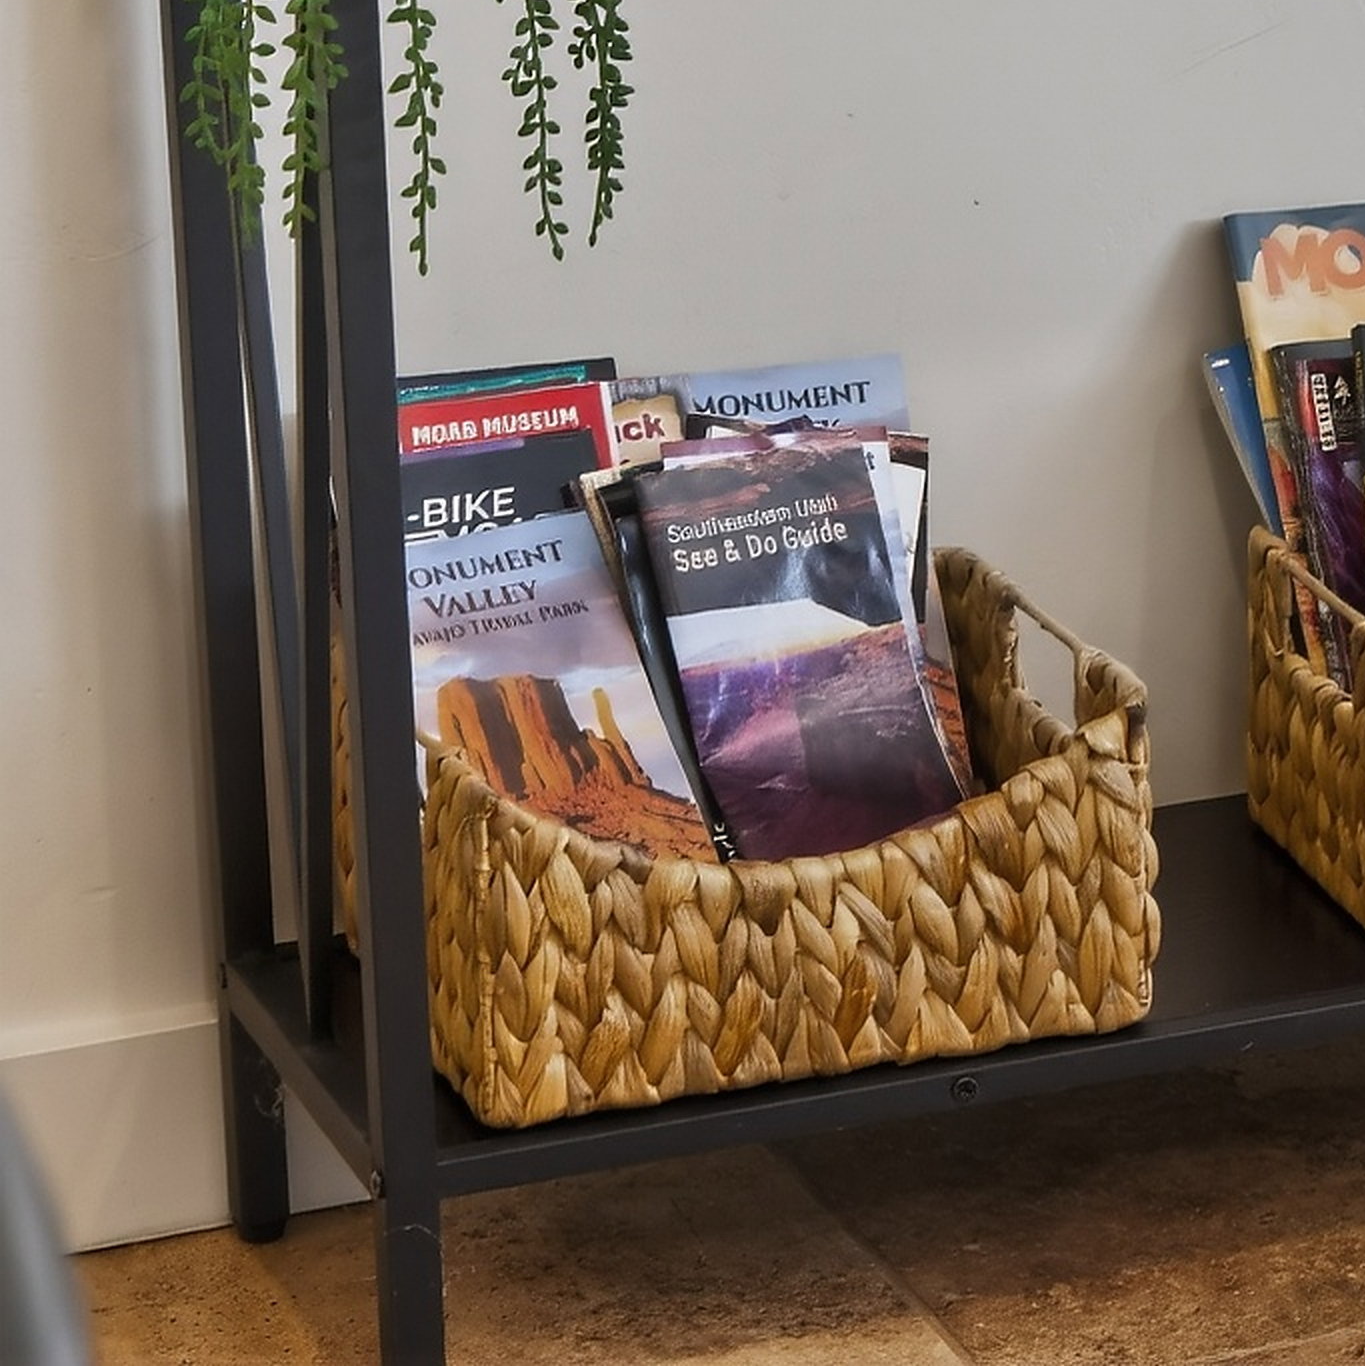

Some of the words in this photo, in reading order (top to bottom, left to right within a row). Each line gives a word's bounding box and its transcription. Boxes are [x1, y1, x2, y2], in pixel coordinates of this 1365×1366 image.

[693, 380, 871, 417] MONUMENT
[482, 406, 579, 439] MUSEUM
[407, 487, 515, 528] -BIKE
[674, 548, 719, 572] See
[724, 539, 742, 563] &
[746, 534, 777, 558] Do
[782, 517, 848, 550] Guide
[408, 540, 563, 588] ONUMENT
[423, 580, 537, 618] VALLEY
[413, 624, 466, 646] AVAJO
